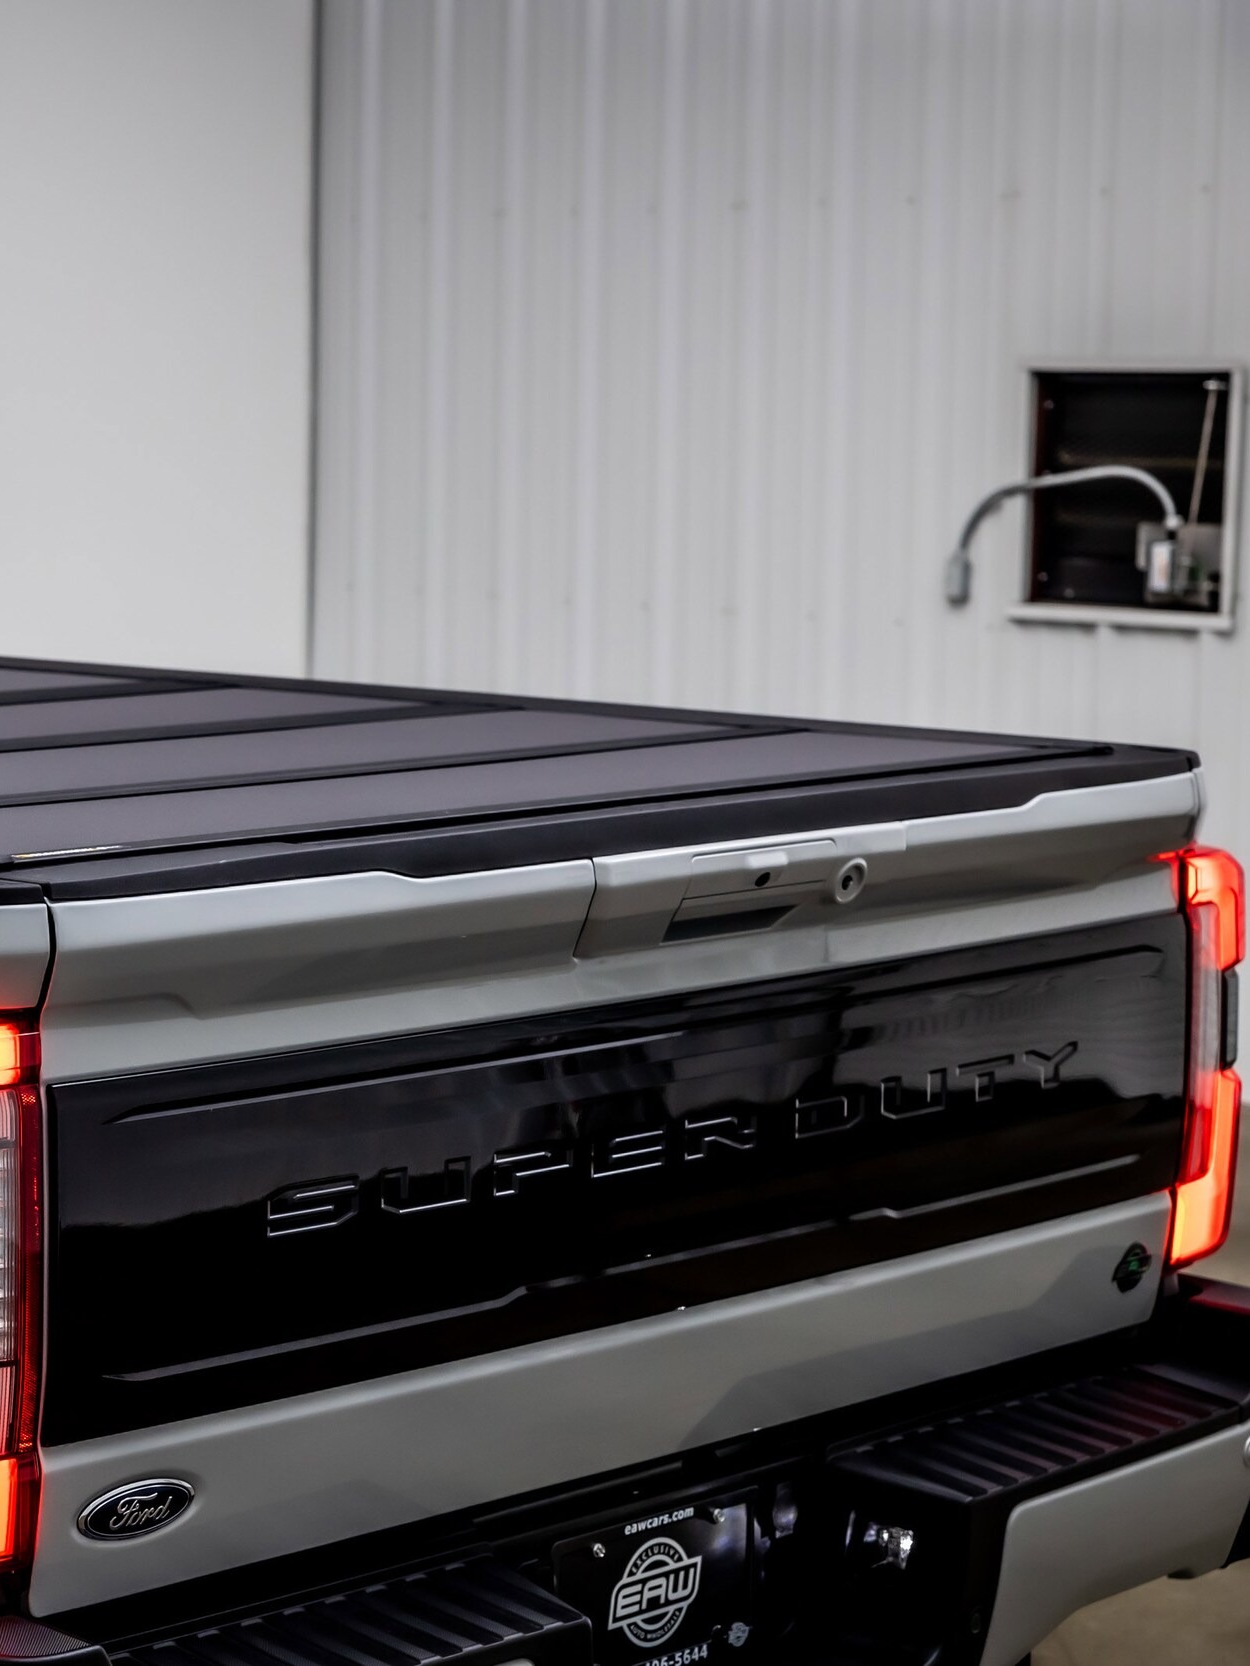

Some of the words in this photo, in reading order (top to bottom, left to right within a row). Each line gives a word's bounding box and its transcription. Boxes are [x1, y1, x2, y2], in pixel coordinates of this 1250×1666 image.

[266, 1115, 756, 1237] SUPER
[795, 1041, 1079, 1139] DUTY
[109, 1492, 173, 1531] Ford
[624, 1507, 695, 1536] eawcars.com
[631, 1544, 680, 1574] EXCLUSIVE
[615, 1567, 696, 1619] EAW
[645, 1644, 709, 1666] 6-5644
